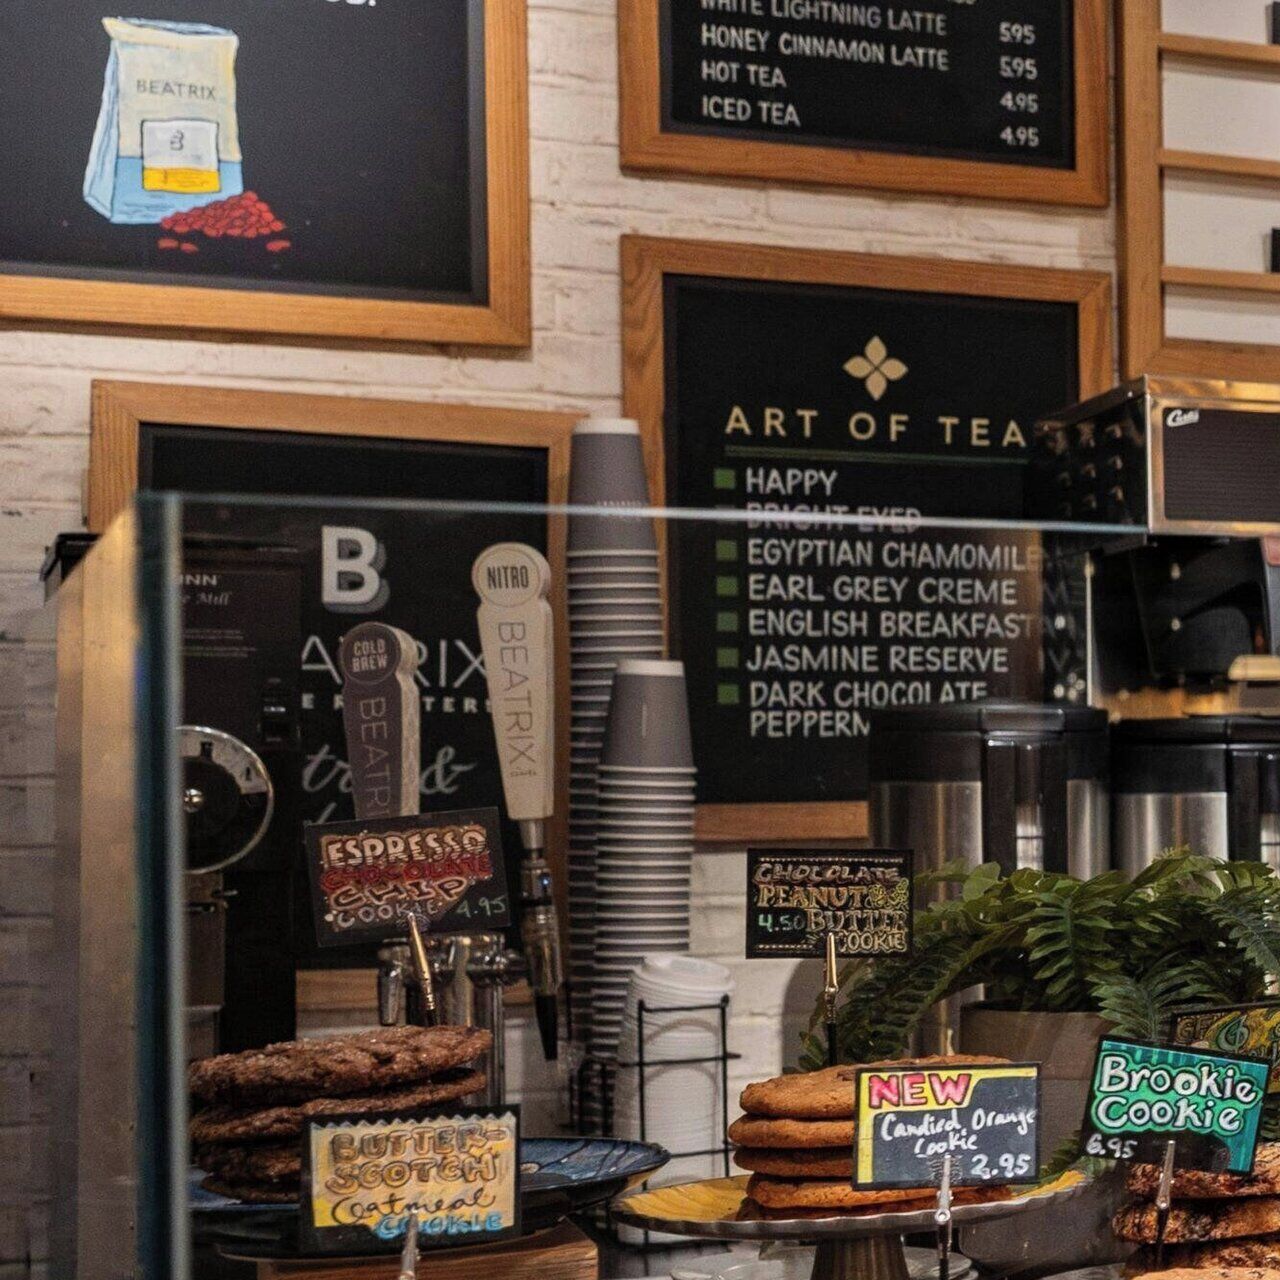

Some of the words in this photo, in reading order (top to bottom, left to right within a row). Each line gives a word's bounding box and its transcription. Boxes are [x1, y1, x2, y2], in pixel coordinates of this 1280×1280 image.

[771, 0, 882, 29] LIGHTNING
[887, 9, 947, 36] LATTE
[701, 23, 771, 51] HONEY
[778, 32, 885, 64] CINNAMON
[891, 45, 949, 71] LATTE
[136, 79, 217, 101] BEATRIX
[701, 60, 739, 84] HOT
[747, 64, 787, 88] TEA
[702, 96, 751, 122] ICED
[758, 101, 801, 127] TEA
[1000, 126, 1040, 148] 4.95
[725, 405, 818, 439] ART
[849, 412, 909, 442] OF
[937, 416, 1027, 448] TEA
[746, 467, 838, 496] HAPPY
[746, 502, 849, 532] BRIGHT
[321, 525, 391, 613] B
[747, 538, 874, 568] EGYPTIAN
[882, 541, 1042, 572] CHAMOMILE
[487, 565, 529, 590] NITRO
[748, 574, 824, 603] EARL
[833, 576, 909, 603] GREY
[918, 577, 1018, 605] CREME
[748, 609, 868, 638] ENGLISH
[879, 611, 1035, 641] BREAKFAST
[353, 639, 386, 655] COLD
[746, 645, 878, 673] JASMINE
[889, 646, 1009, 674] RESERVE
[352, 654, 388, 673] BREW
[498, 621, 536, 765] BEATRIX
[750, 680, 826, 709] DARK
[326, 829, 487, 866] ESPRESSO
[321, 854, 492, 890] CHOCOLATE
[754, 863, 900, 884] CHOCOLATE
[330, 876, 467, 909] CHIP
[455, 897, 507, 919] 4.95
[756, 884, 866, 908] PEANUT
[758, 913, 806, 932] 4.50
[805, 908, 908, 932] BUTTER
[838, 933, 907, 953] COOKIE
[868, 1072, 972, 1109] NEW
[1099, 1054, 1258, 1104] Brookie
[881, 1108, 962, 1142] Candied
[972, 1107, 1037, 1136] Orange
[1096, 1096, 1241, 1132] Cookie
[914, 1129, 979, 1158] Cookie
[325, 1152, 499, 1194] SCOTCH
[331, 1188, 497, 1226] Oatmeal
